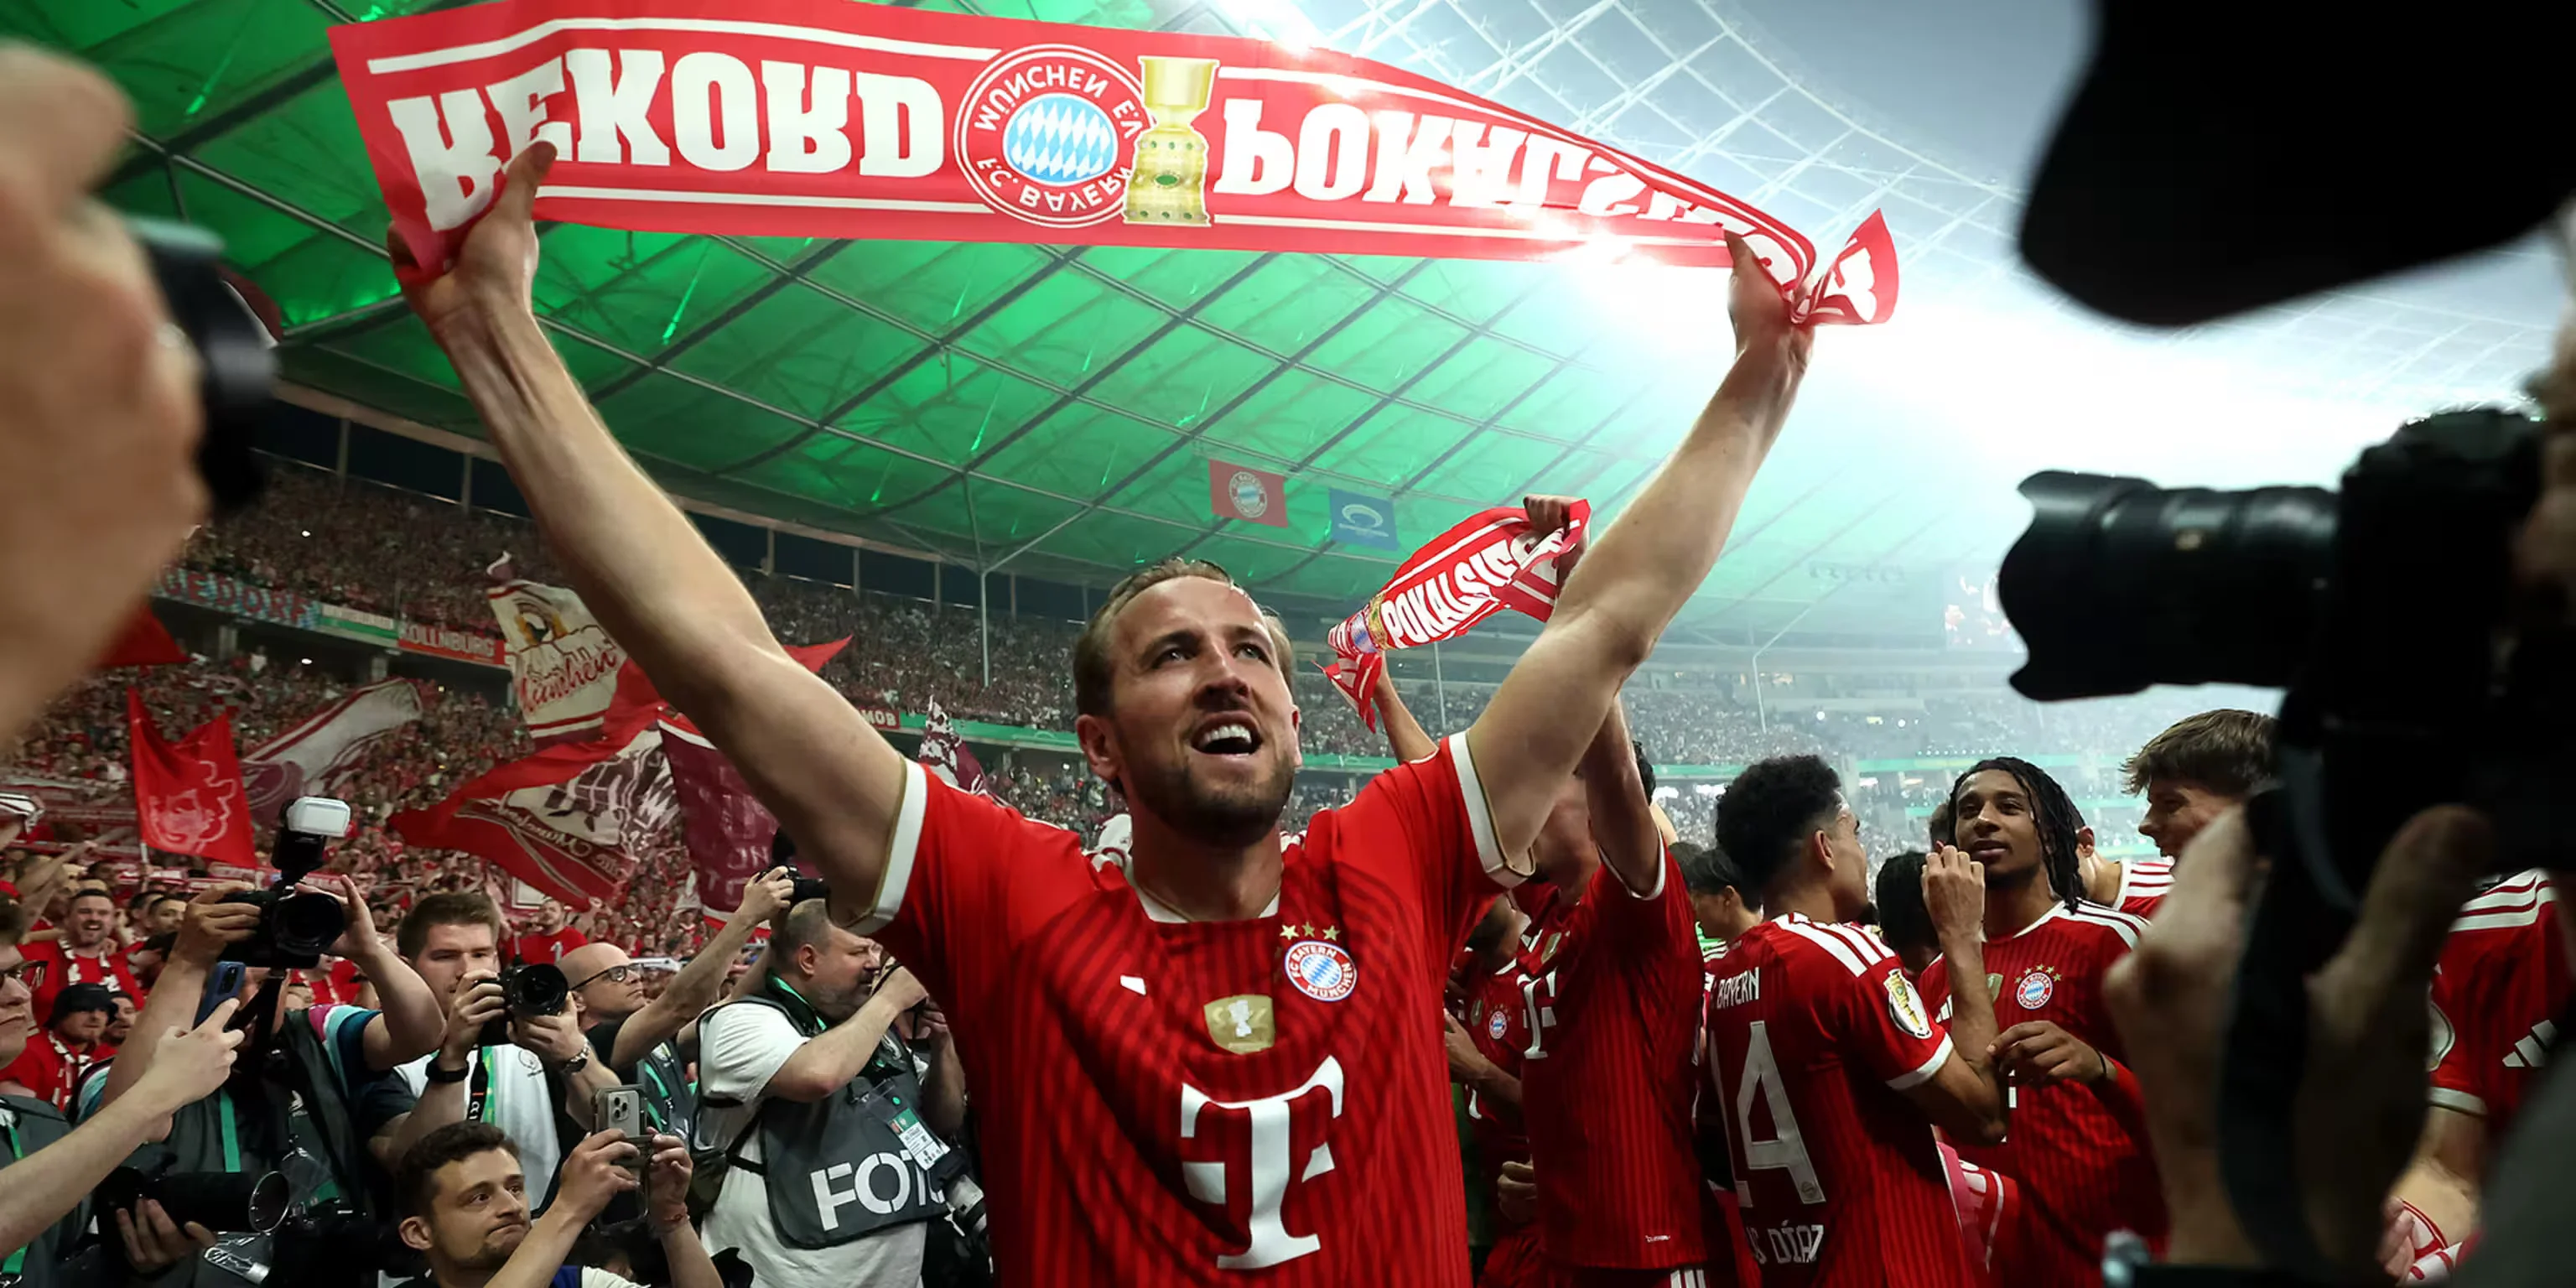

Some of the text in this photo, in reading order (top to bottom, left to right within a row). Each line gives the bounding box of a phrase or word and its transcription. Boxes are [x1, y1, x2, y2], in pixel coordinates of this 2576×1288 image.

[1291, 945, 1337, 963] BAYERN
[1716, 966, 1760, 1009] BAYERN
[1768, 1219, 1825, 1265] DÍAZ
